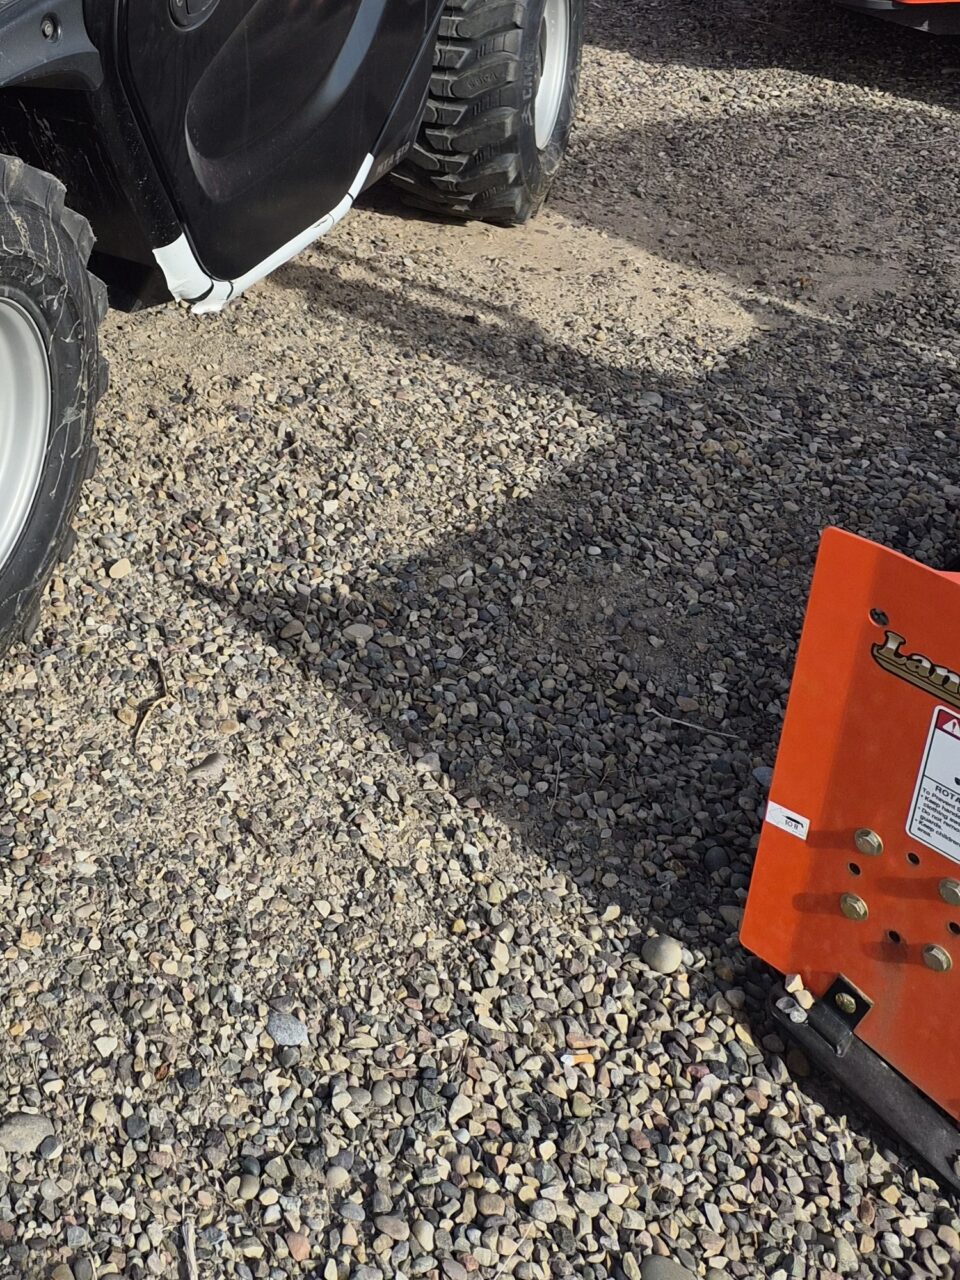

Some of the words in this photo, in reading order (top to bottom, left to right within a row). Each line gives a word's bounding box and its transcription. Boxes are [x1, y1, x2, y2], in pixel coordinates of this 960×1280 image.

[878, 631, 960, 694] Lan
[925, 796, 940, 808] Keep
[935, 785, 960, 804] ROTA
[921, 808, 930, 816] Do
[931, 814, 942, 823] not
[923, 803, 948, 820] clothing
[919, 820, 934, 832] Keep
